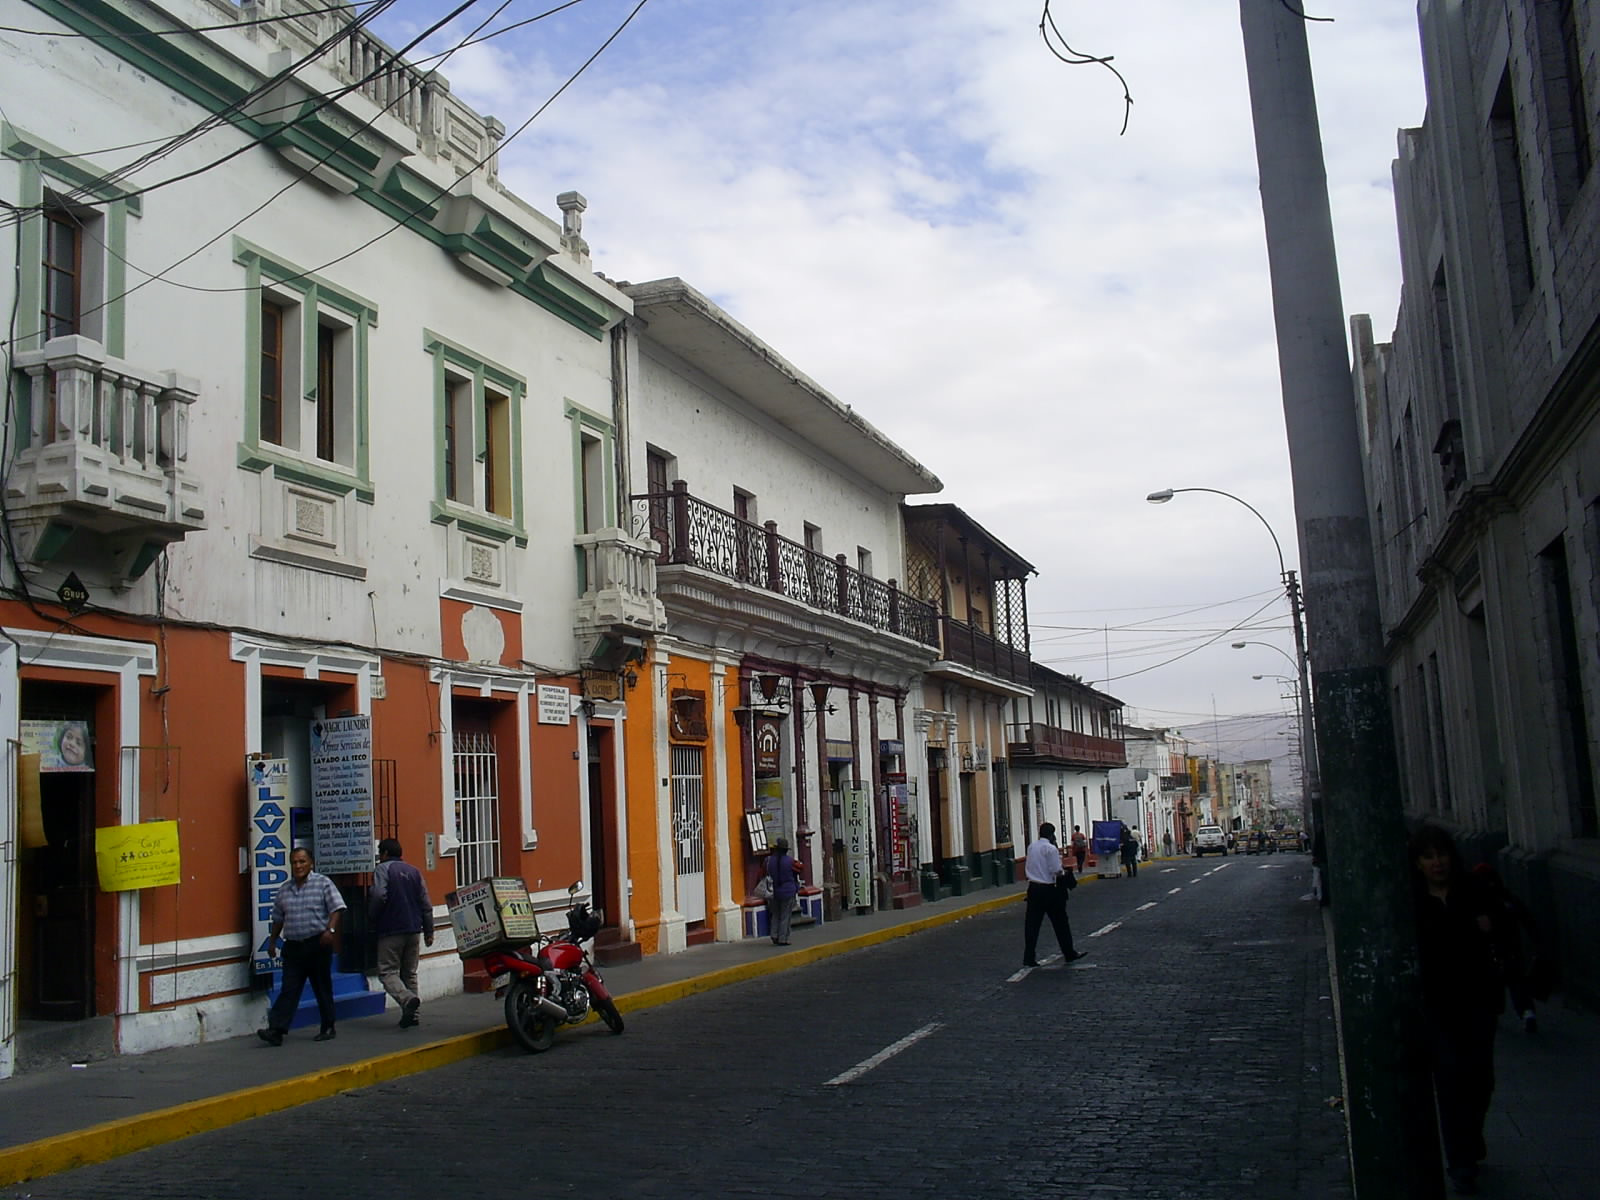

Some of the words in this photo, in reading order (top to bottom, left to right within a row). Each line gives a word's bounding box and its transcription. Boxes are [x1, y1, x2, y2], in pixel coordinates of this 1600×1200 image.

[323, 720, 340, 732] MAGIC
[343, 718, 370, 731] LAUNDRY
[313, 756, 340, 764] LAVADO
[315, 789, 340, 797] LAVADO
[849, 793, 862, 853] TREKKING
[853, 862, 861, 906] COLCA
[461, 887, 488, 904] FENIX
[457, 920, 497, 940] DELIVERY
